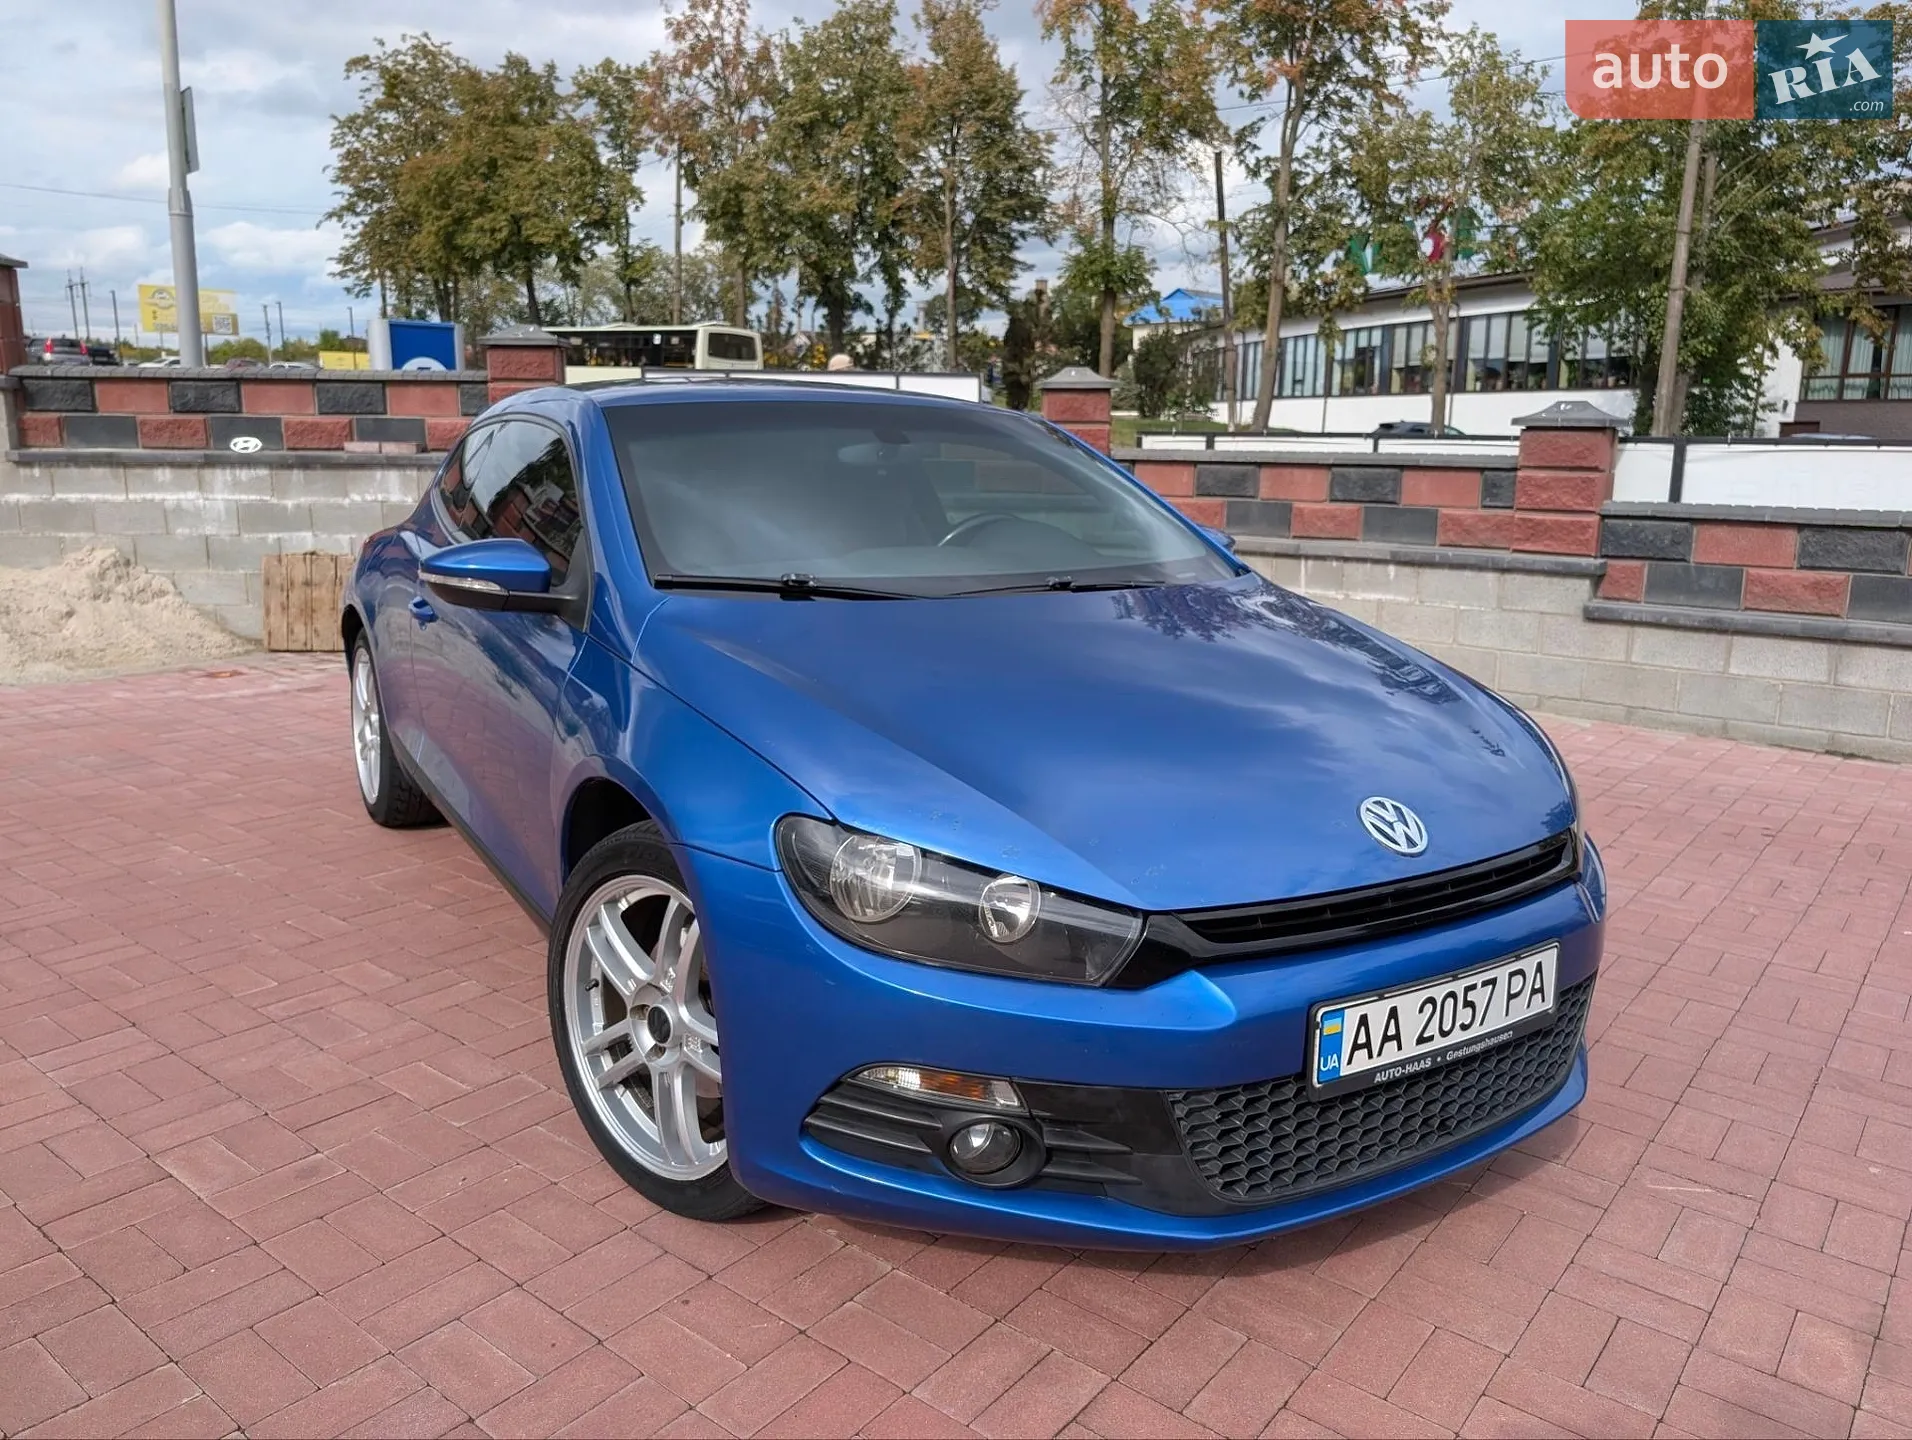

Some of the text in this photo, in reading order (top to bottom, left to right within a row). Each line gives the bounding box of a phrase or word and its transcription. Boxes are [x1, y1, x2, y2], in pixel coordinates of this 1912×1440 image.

[1347, 960, 1546, 1066] AA 2057 PA
[1320, 1053, 1339, 1072] UA
[1374, 1057, 1432, 1084] AUTO-HAAS
